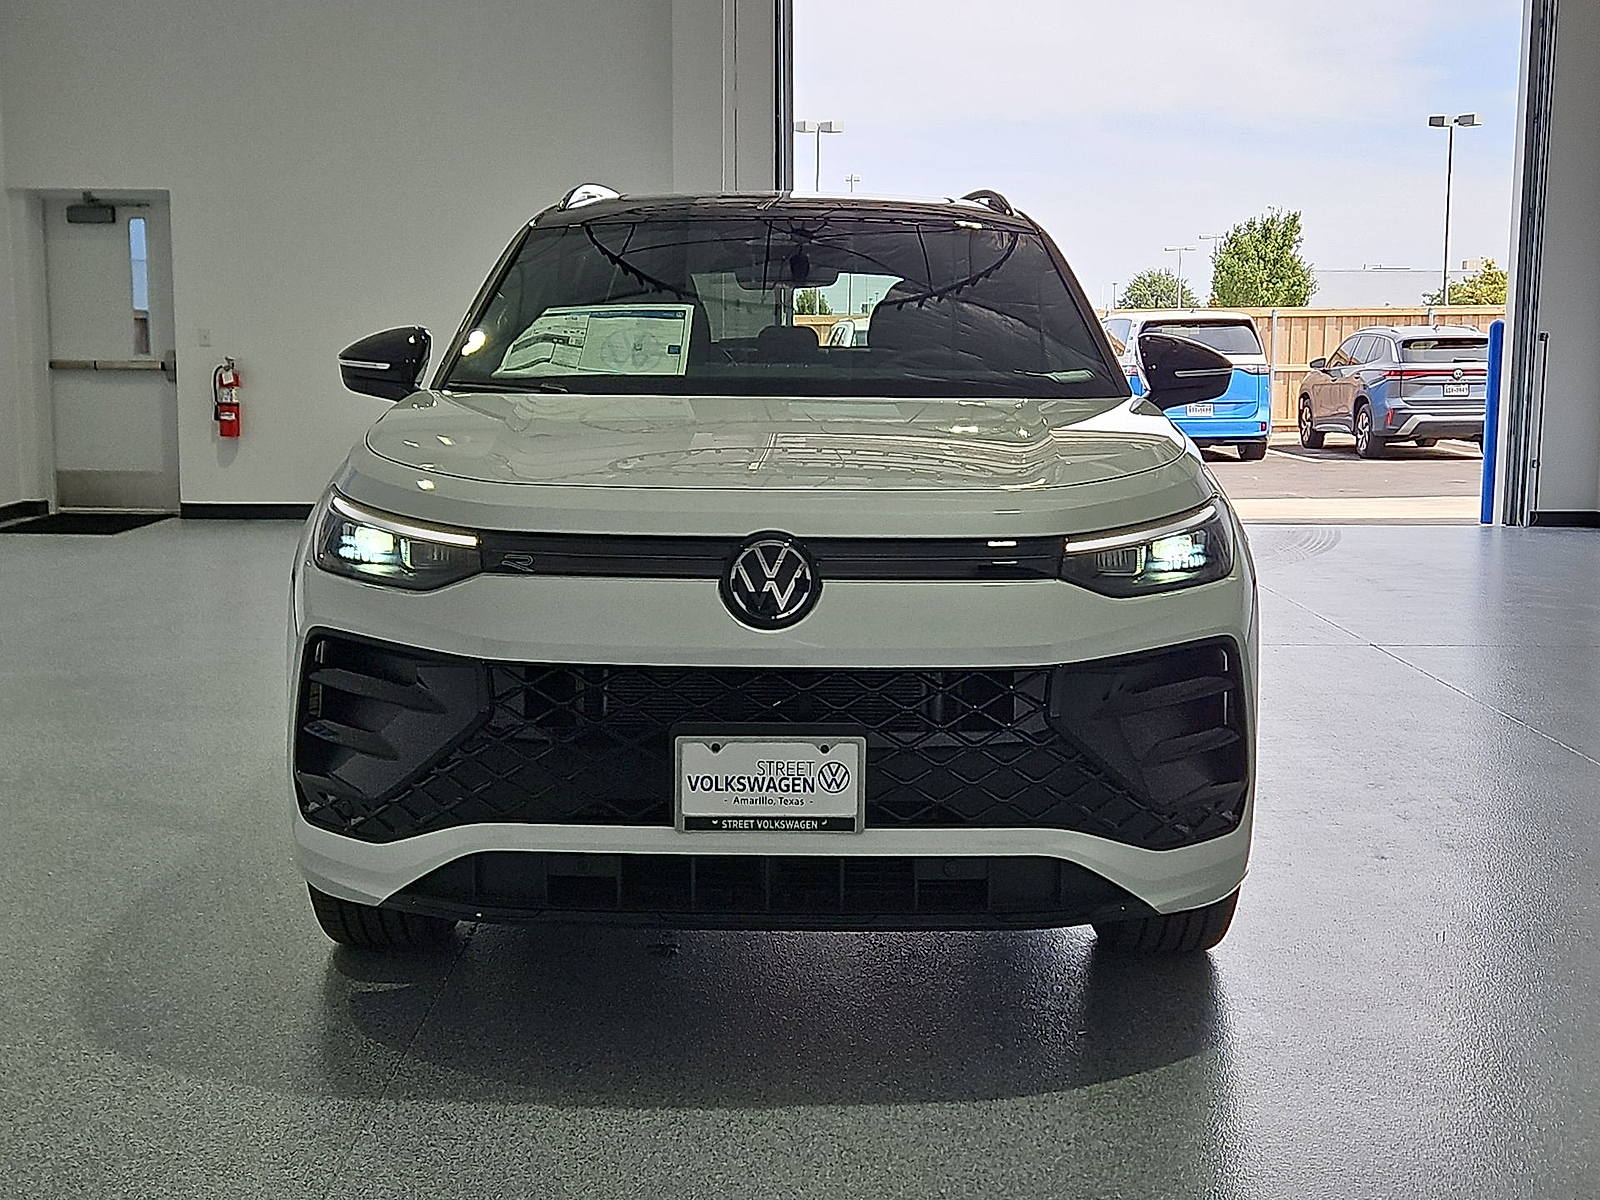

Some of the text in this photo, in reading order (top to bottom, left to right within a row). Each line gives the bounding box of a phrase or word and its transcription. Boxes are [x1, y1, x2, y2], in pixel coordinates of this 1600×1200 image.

[756, 761, 815, 776] STREET
[687, 776, 815, 793] VOLKSWAGEN
[778, 796, 804, 806] Texas
[722, 820, 818, 829] STREET VOLKSWAGEN
